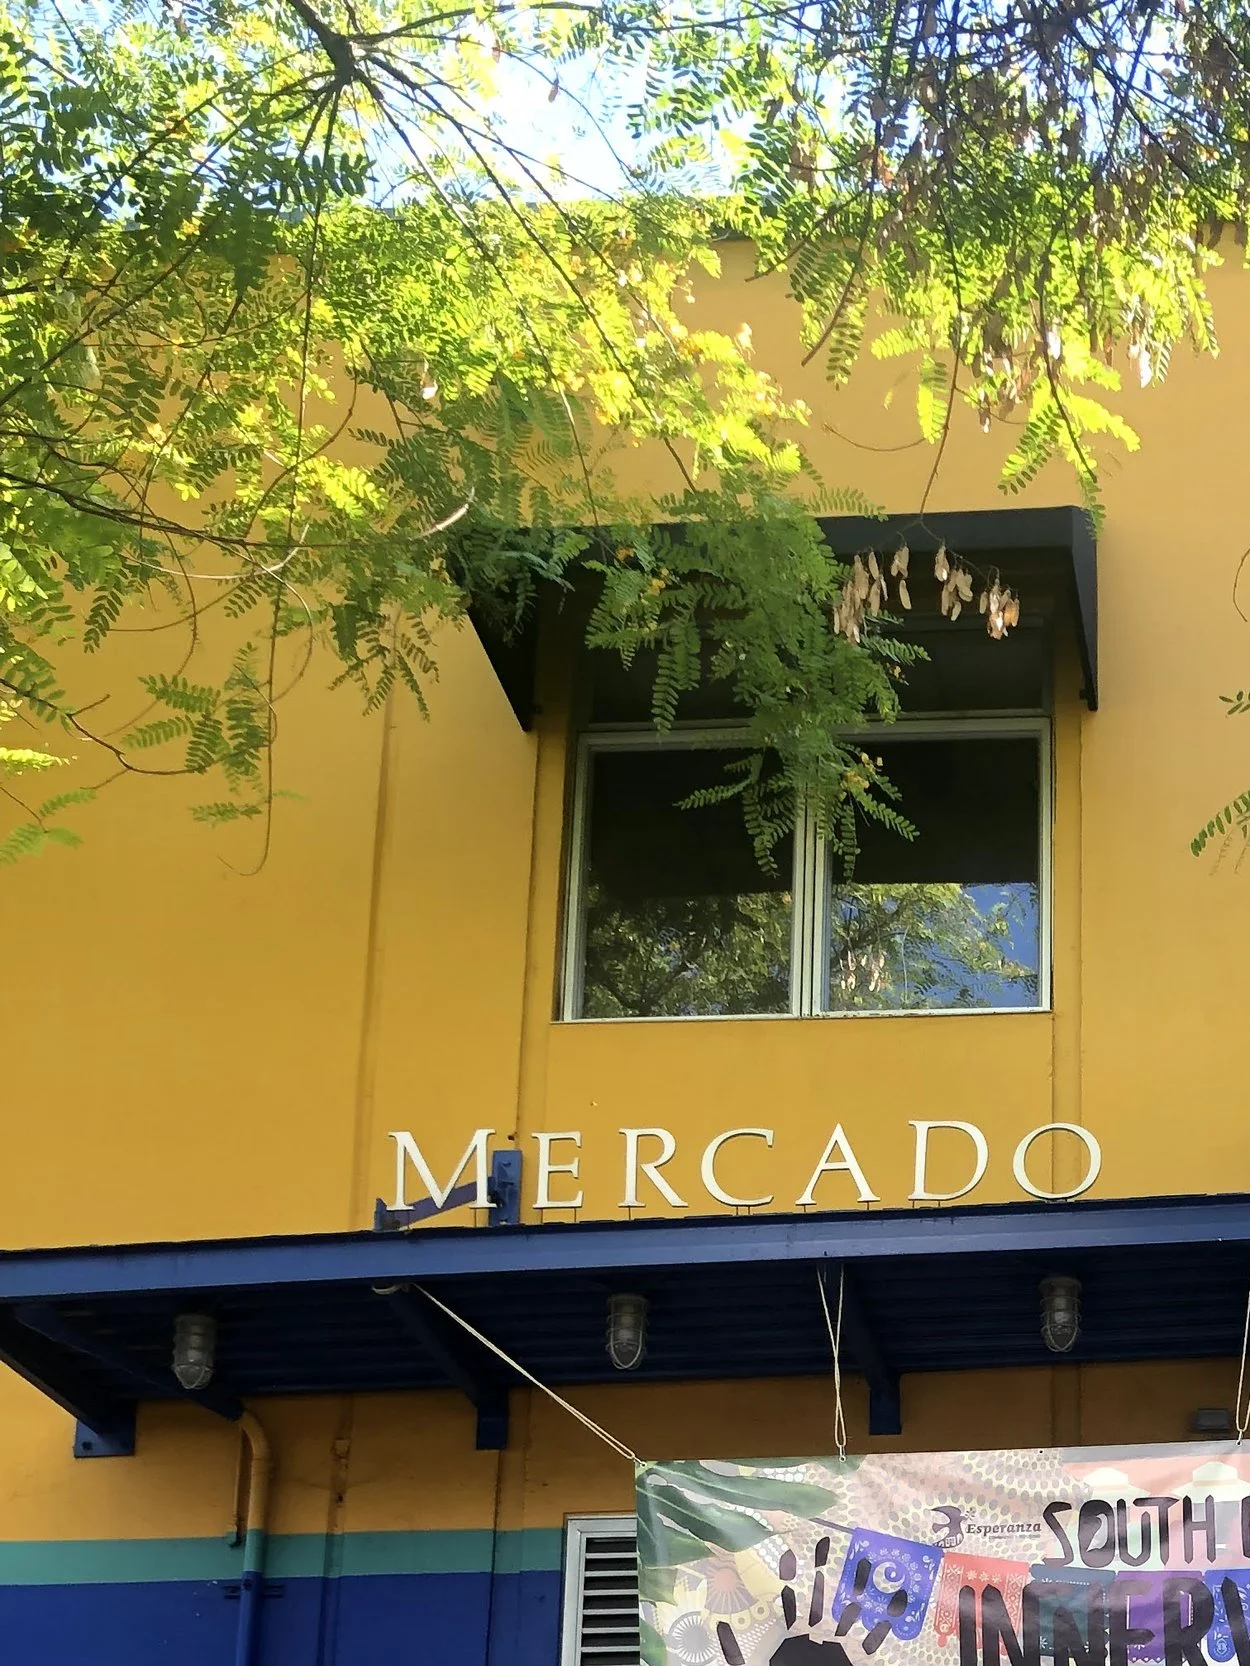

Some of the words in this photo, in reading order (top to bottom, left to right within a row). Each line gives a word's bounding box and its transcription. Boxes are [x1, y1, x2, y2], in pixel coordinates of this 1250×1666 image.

[387, 1119, 1102, 1212] MERCADO
[966, 1523, 1042, 1537] Esperanza
[1042, 1493, 1215, 1568] SOUTH
